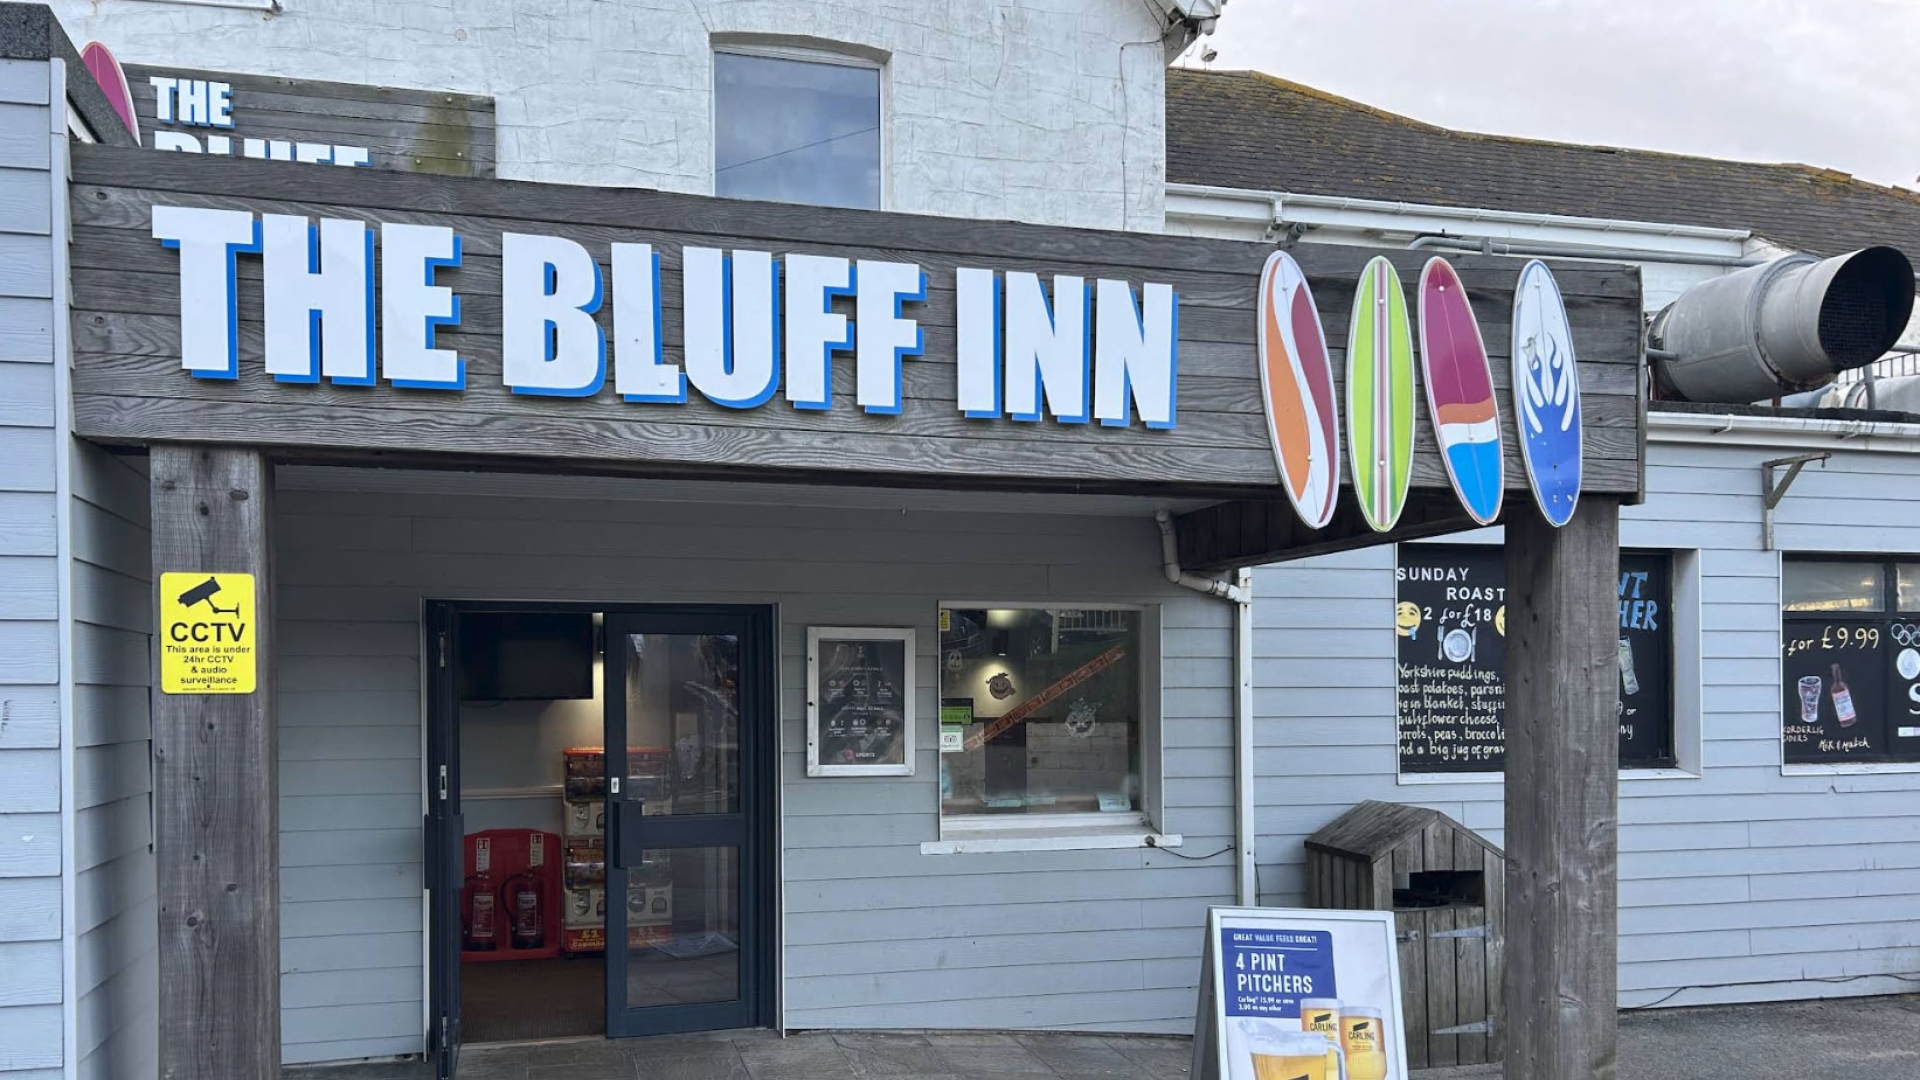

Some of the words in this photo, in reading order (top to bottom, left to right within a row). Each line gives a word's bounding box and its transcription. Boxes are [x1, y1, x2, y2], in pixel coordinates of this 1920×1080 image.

[150, 76, 235, 128] THE
[152, 205, 465, 390] THE
[502, 232, 926, 413] BLUFF
[957, 267, 1179, 430] INN
[1396, 567, 1469, 581] SUNDAY
[1446, 587, 1505, 602] ROAST
[1423, 607, 1432, 620] 2
[1439, 607, 1461, 624] for
[1461, 603, 1492, 628] £18
[1618, 600, 1658, 632] HER
[170, 622, 246, 642] CCTV
[1788, 639, 1814, 656] for
[1821, 625, 1880, 649] £9.99
[166, 645, 187, 654] This
[189, 646, 210, 654] area
[212, 645, 221, 654] is
[223, 645, 250, 654] under
[183, 655, 204, 663] 24hr
[207, 655, 234, 663] CCTV
[191, 666, 198, 674] &
[201, 666, 227, 674] audio
[1398, 663, 1446, 678] Yorkshire
[1447, 664, 1499, 684] puddings,
[180, 676, 238, 684] surveillance
[1399, 680, 1419, 694] oast
[1470, 682, 1505, 698] parsni
[1618, 723, 1633, 740] ny
[1399, 741, 1413, 754] nd
[1430, 741, 1448, 760] big
[1451, 743, 1469, 761] jug
[1483, 745, 1505, 760] grav
[1233, 933, 1253, 941] GREAT
[1255, 934, 1274, 942] VALUE
[1236, 952, 1245, 970] 4
[1251, 952, 1286, 971] PINT
[1237, 973, 1313, 994] PITCHERS
[1309, 1022, 1337, 1031] CARLING
[1348, 1030, 1375, 1041] CARLING
